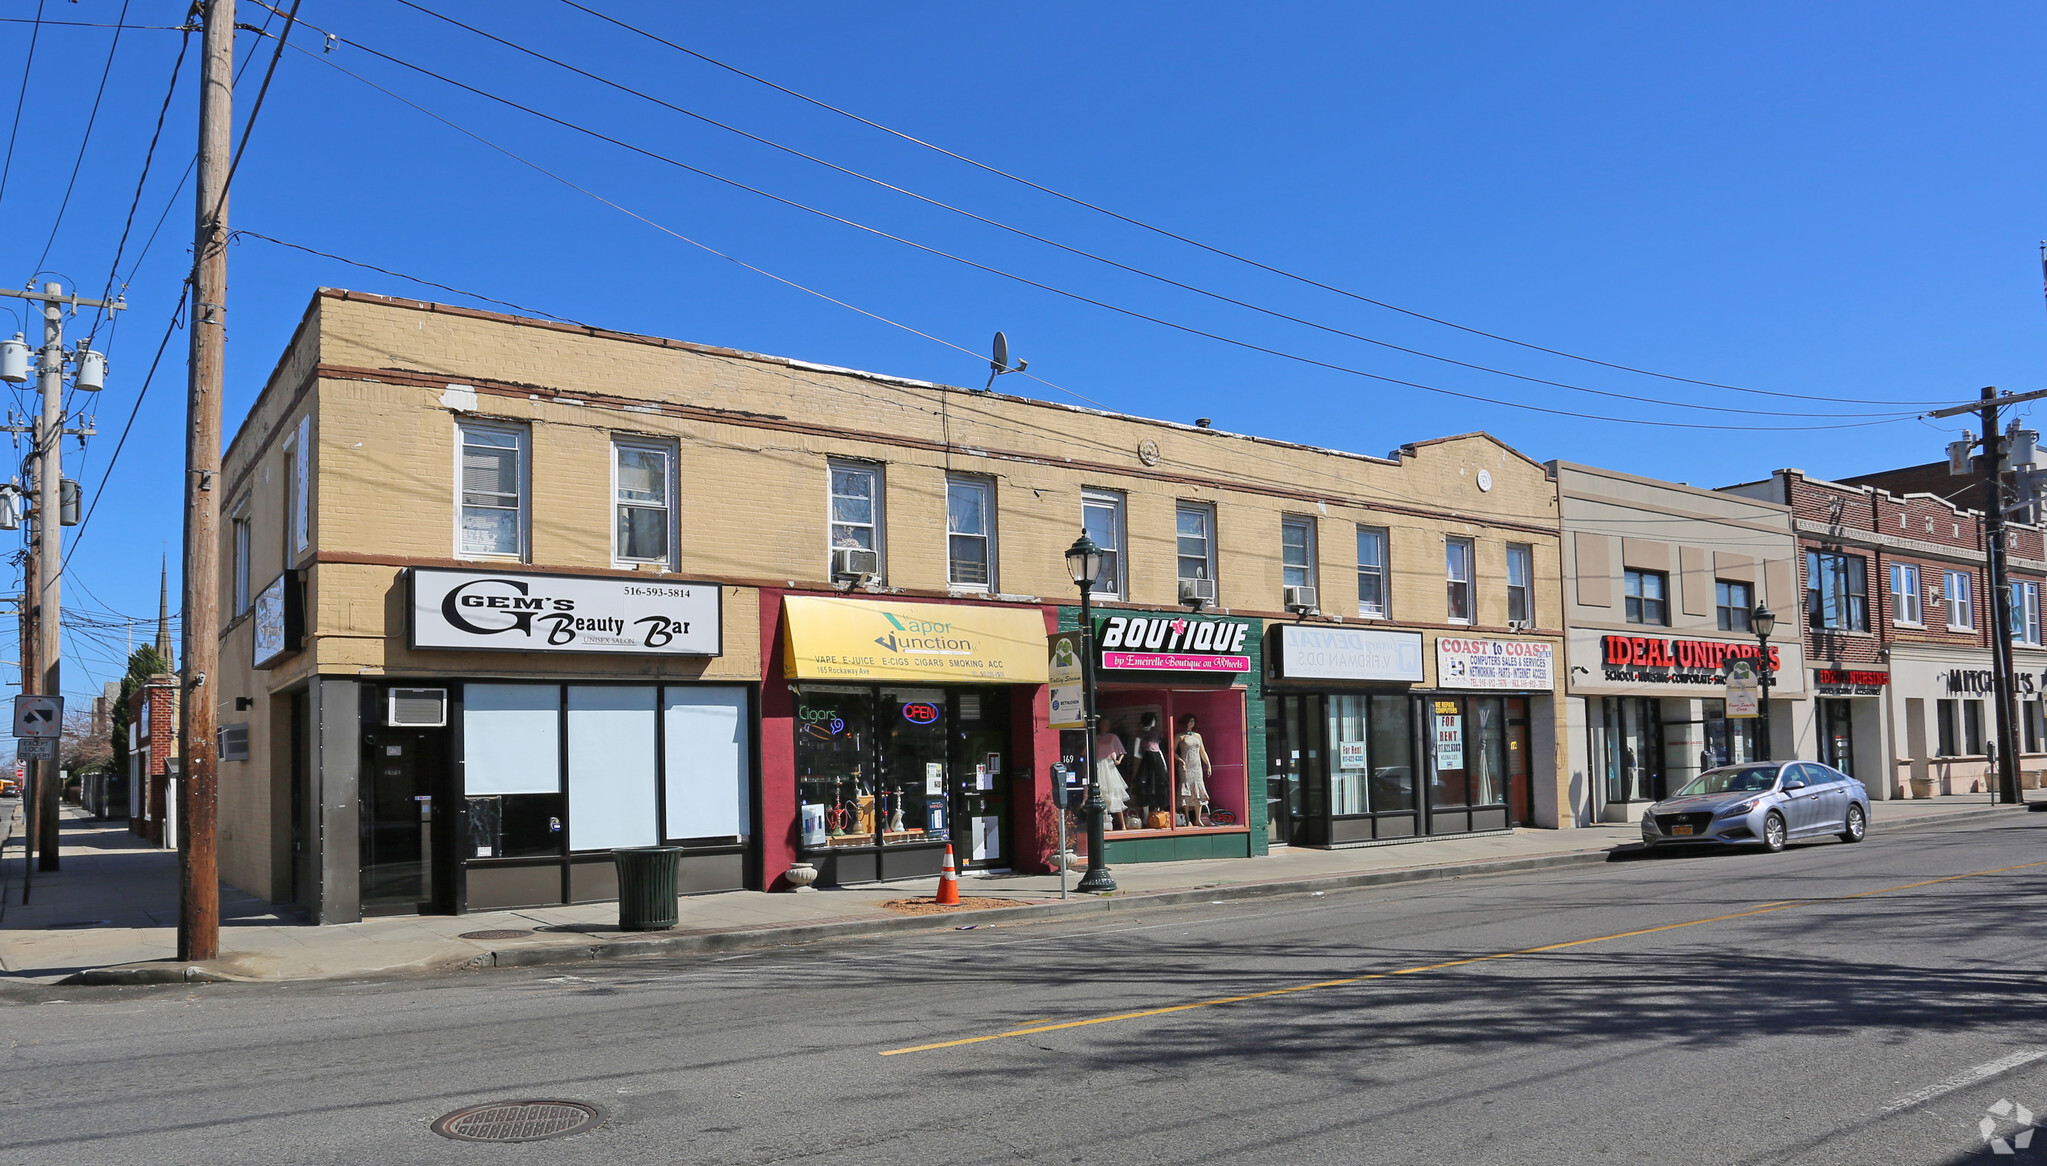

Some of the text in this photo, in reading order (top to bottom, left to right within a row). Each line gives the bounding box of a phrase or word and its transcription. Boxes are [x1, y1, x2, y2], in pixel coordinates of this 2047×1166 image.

[624, 586, 691, 598] 516-593-5814
[461, 595, 575, 611] GEM'S
[537, 612, 691, 648] Beauty Bar
[1102, 617, 1249, 652] BOUTIQUE
[583, 636, 635, 645] UNISEX SALON
[874, 630, 971, 653] Junction
[1441, 639, 1488, 655] COAST
[1492, 642, 1503, 655] to
[1505, 643, 1549, 657] COAST
[1606, 635, 1675, 667] IDEAL
[814, 655, 1004, 668] VAPE E-JUICE E-CIGS CIGARS SMOKING ACC
[1114, 656, 1124, 668] by
[1165, 656, 1202, 669] Boutique
[1213, 657, 1243, 669] Wheels
[1470, 656, 1501, 666] COMPUTERS
[1502, 657, 1517, 667] SALES
[1523, 658, 1546, 668] SERVICES
[828, 667, 858, 676] Rockaway
[1605, 670, 1636, 682] SCHOOL
[1849, 671, 1889, 685] NURSING
[799, 705, 837, 724] Cigars
[904, 705, 935, 719] OPEN
[1442, 716, 1455, 726] FOR
[1440, 731, 1458, 741] RENT
[1342, 745, 1350, 754] For
[1063, 755, 1074, 763] 169
